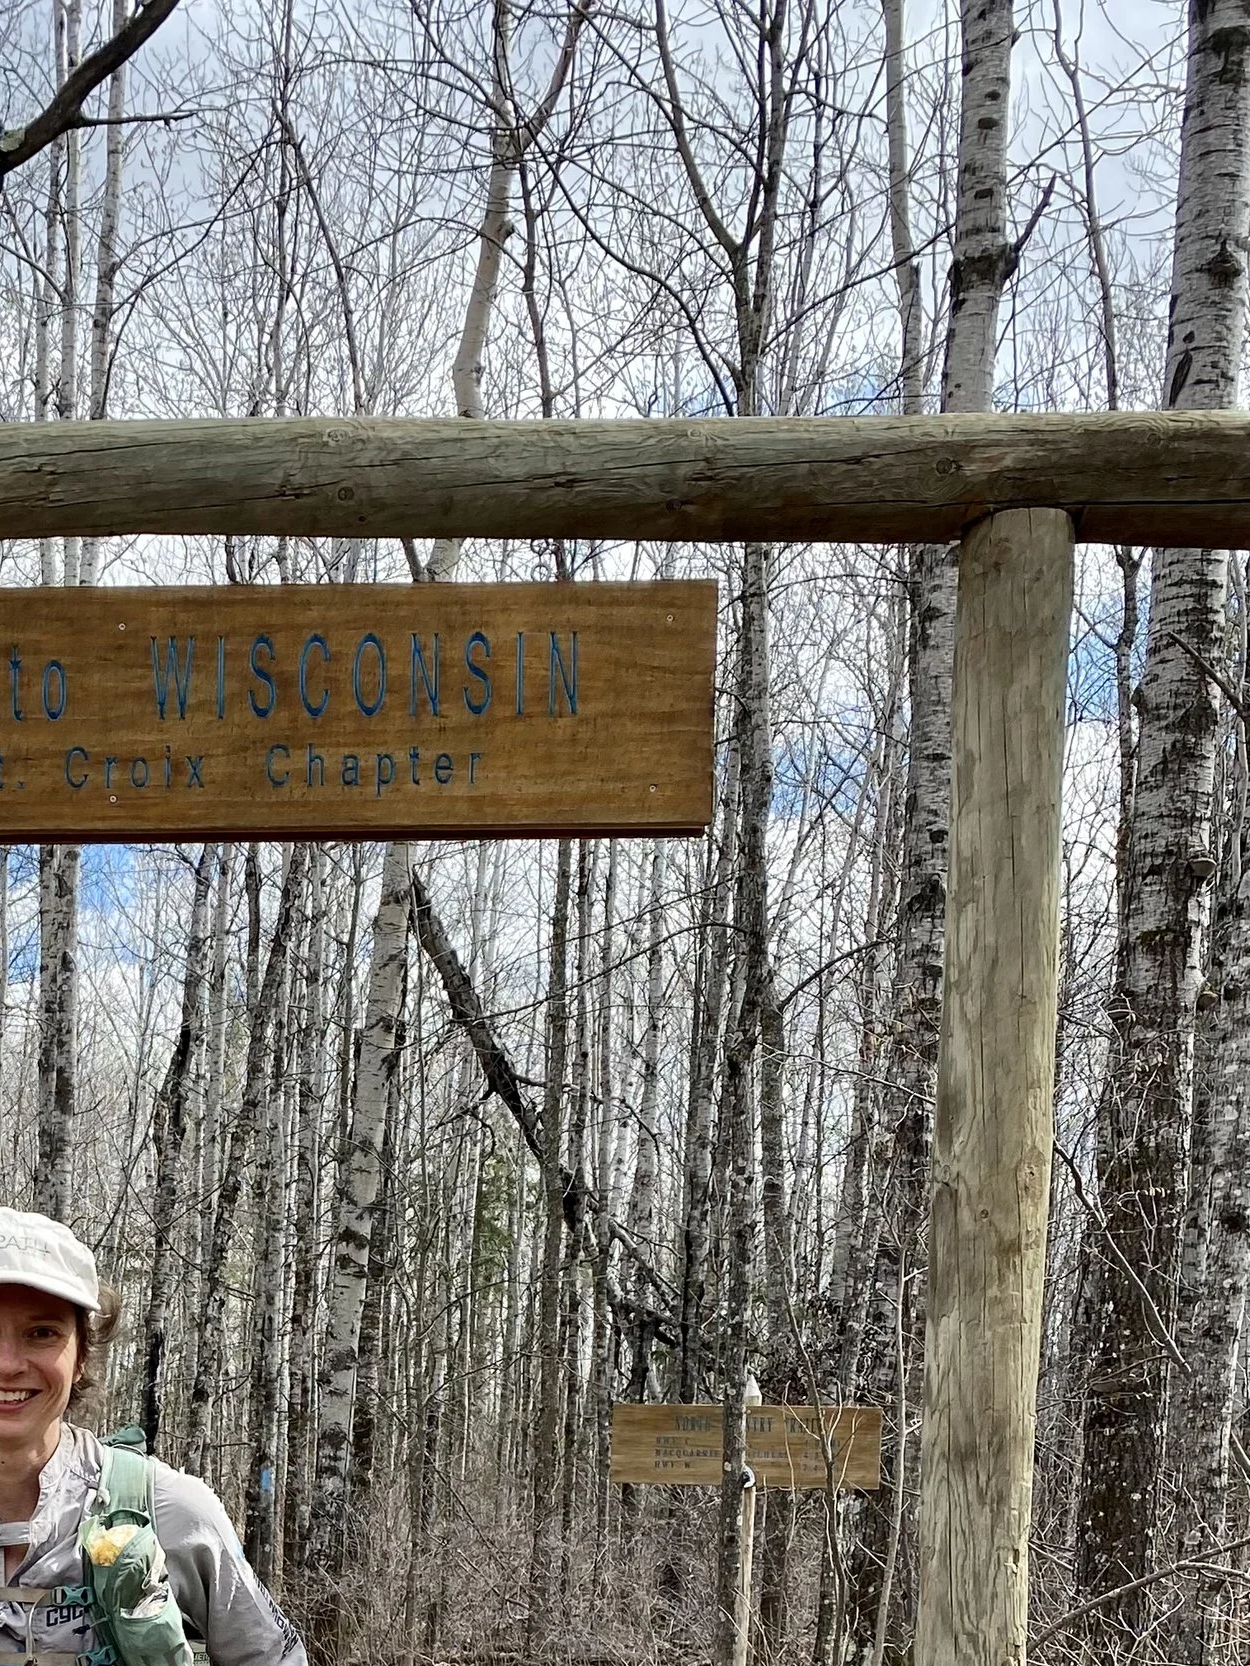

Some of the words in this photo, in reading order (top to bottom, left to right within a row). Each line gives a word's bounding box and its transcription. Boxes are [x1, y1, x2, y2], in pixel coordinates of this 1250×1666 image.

[9, 643, 68, 723] to
[150, 630, 579, 720] WISCONSIN
[64, 745, 205, 789] Croix
[265, 744, 484, 797] Chapter
